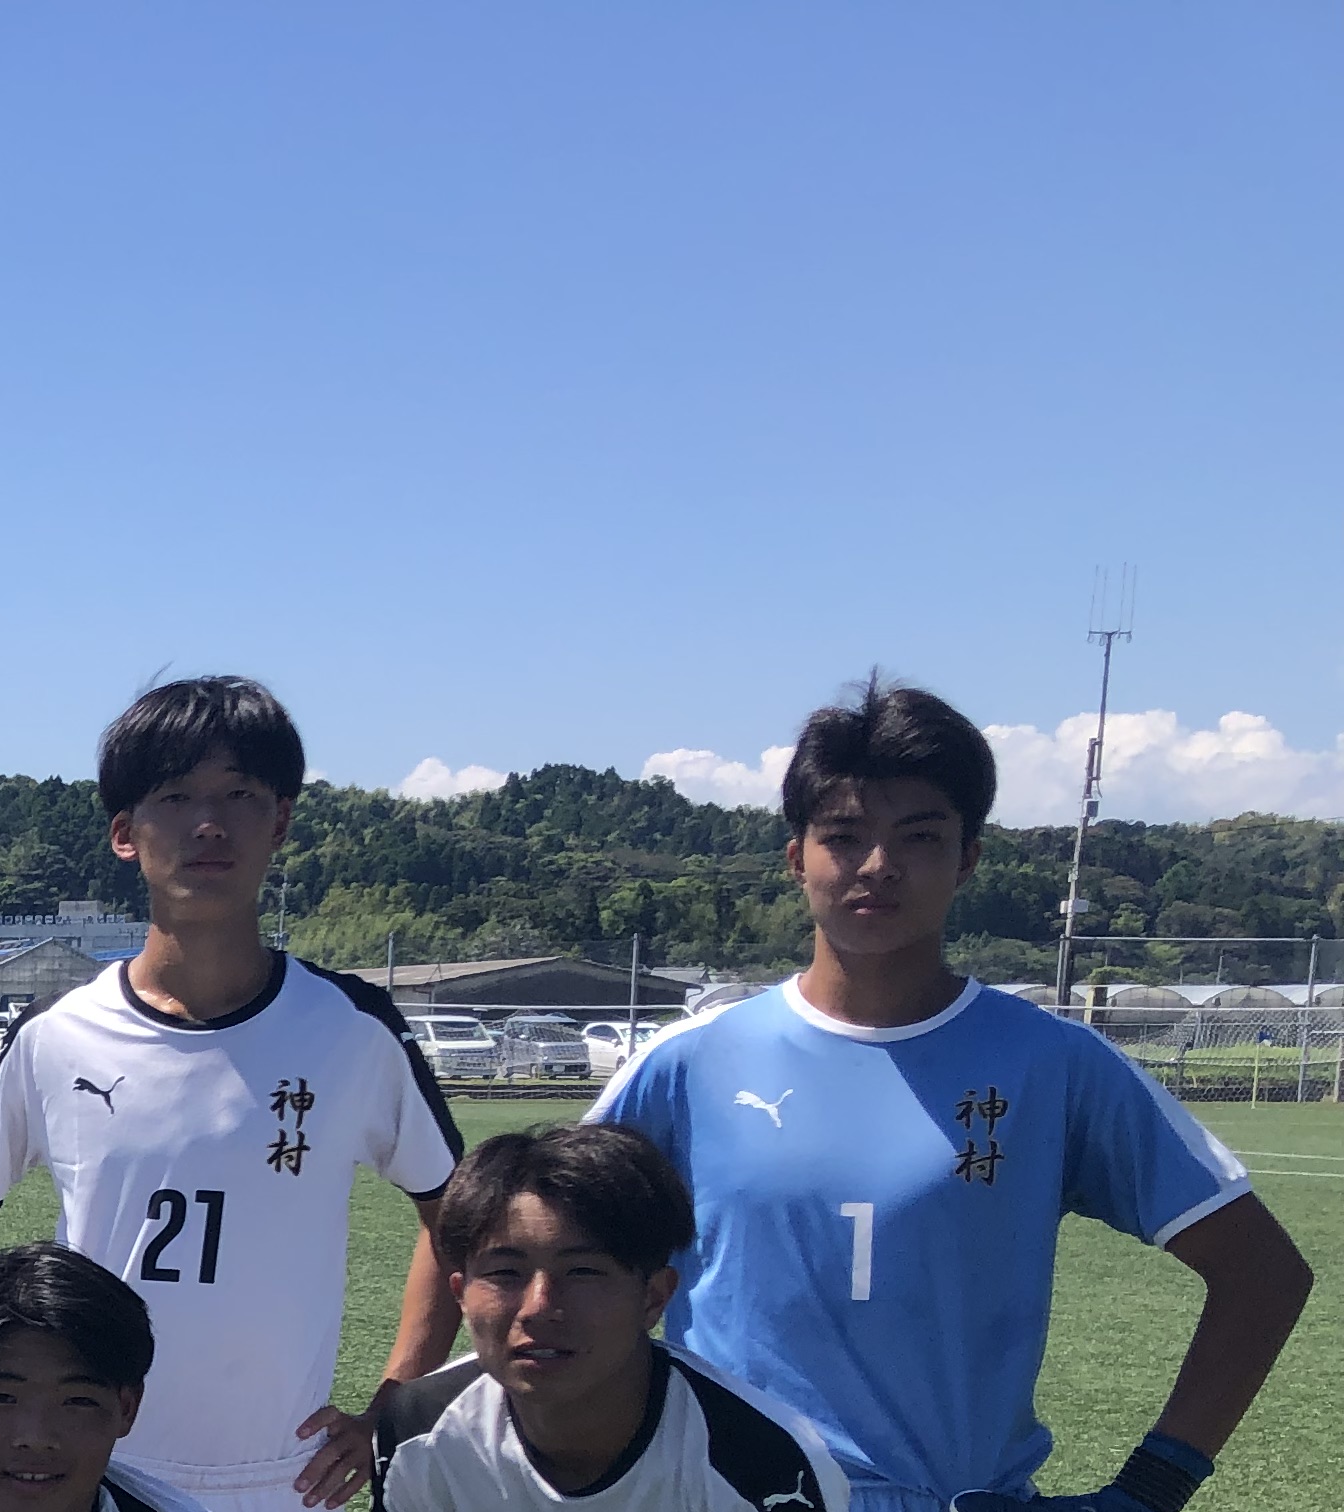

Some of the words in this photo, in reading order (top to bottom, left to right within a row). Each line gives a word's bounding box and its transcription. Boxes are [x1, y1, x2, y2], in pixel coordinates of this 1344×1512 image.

[265, 1077, 315, 1177] 神村
[954, 1086, 1009, 1187] 神村
[140, 1188, 226, 1285] 21
[840, 1202, 874, 1301] 1
